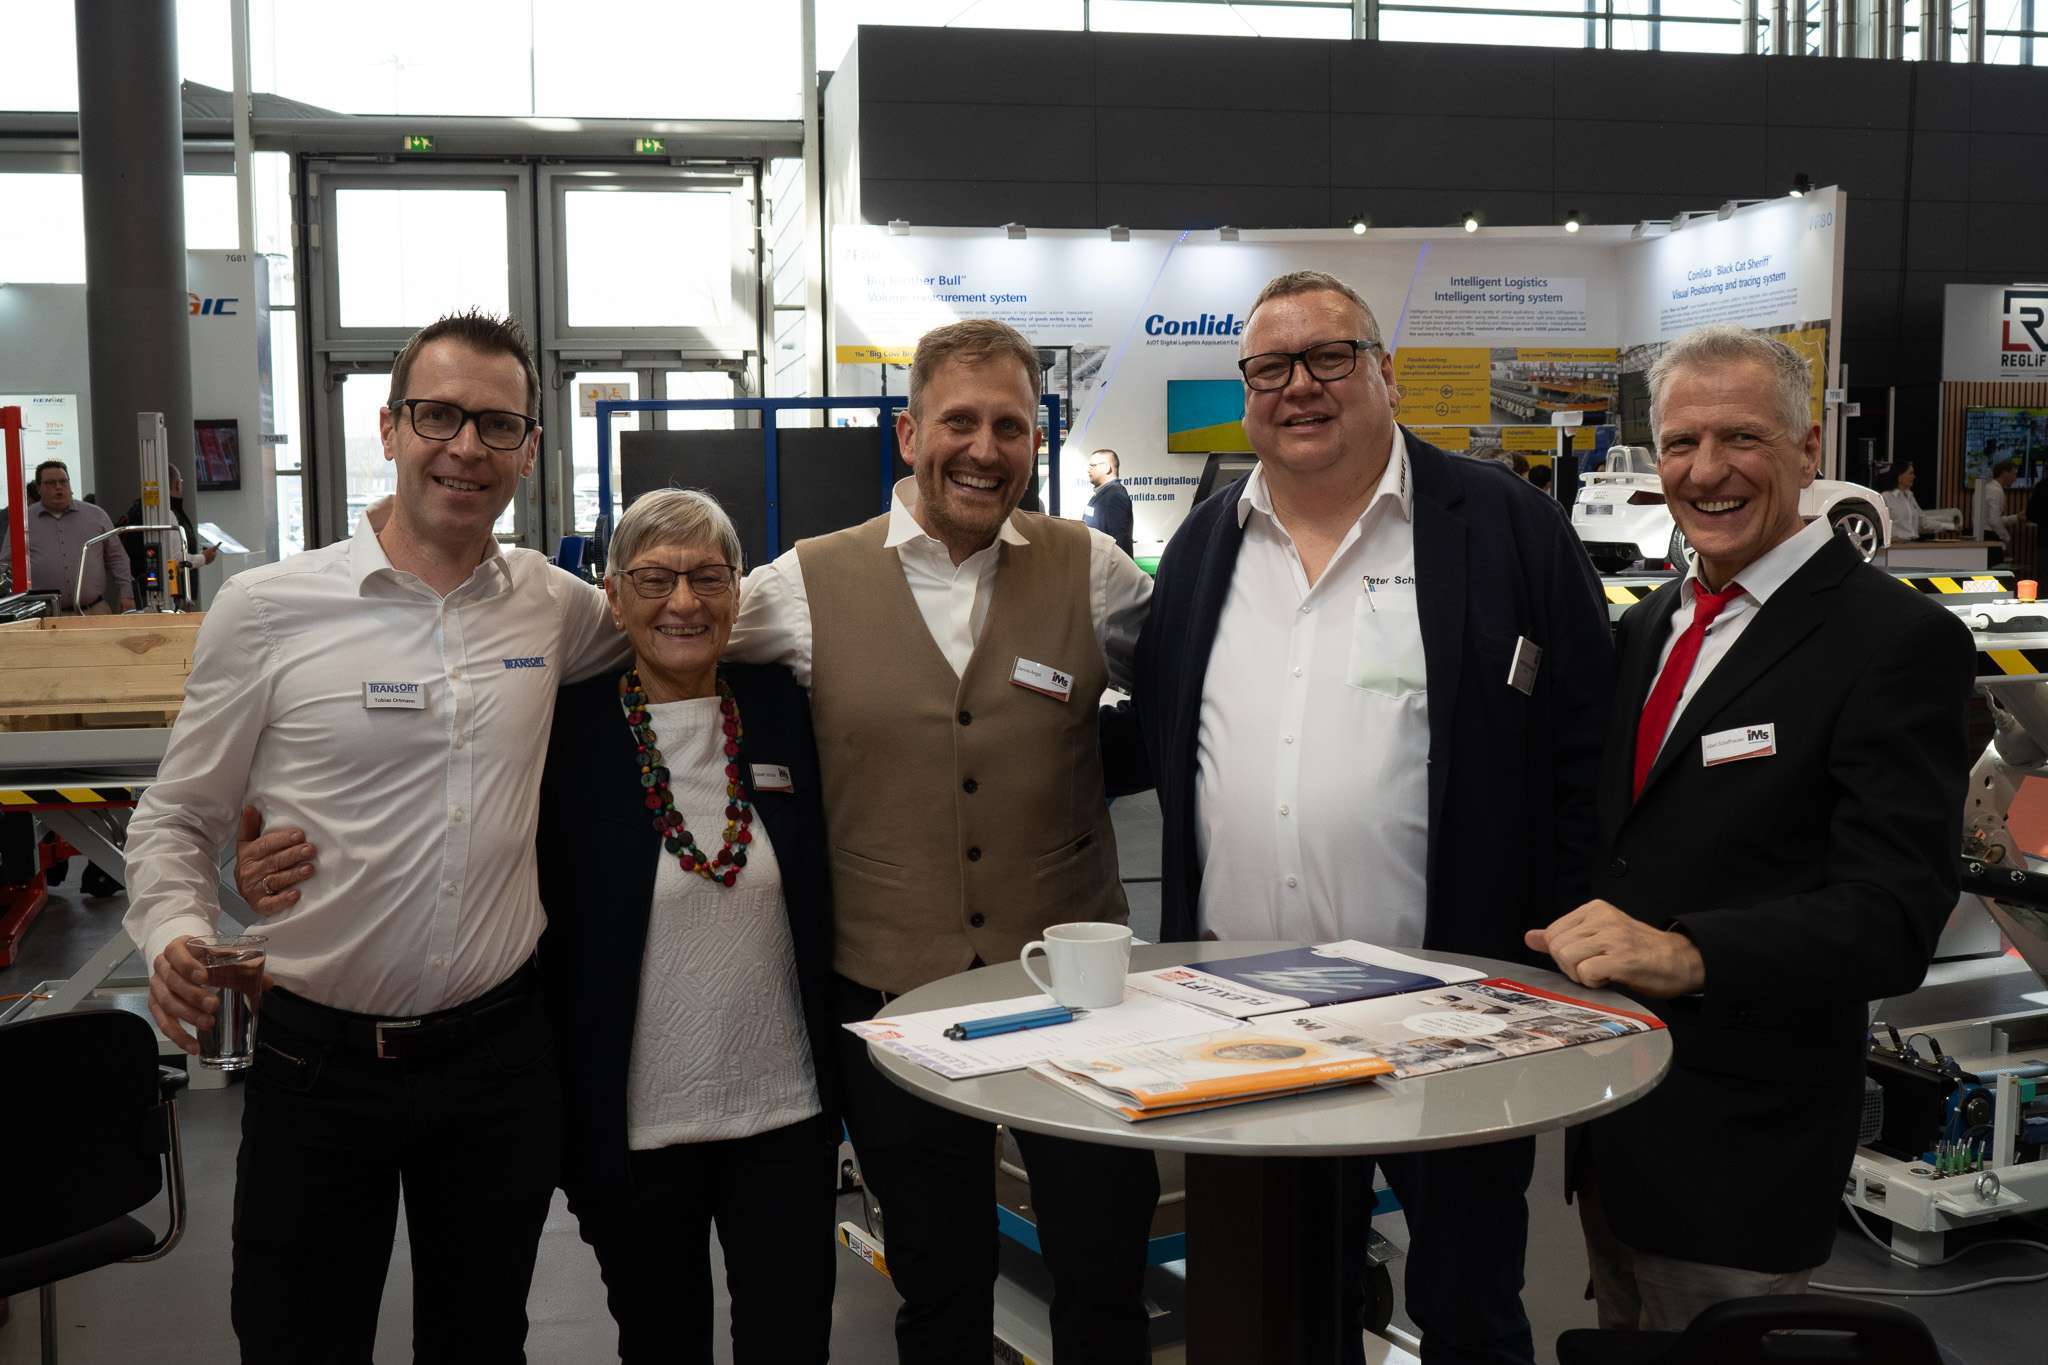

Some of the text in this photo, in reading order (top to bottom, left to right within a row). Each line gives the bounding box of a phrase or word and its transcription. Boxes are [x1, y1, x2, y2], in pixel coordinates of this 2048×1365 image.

[225, 254, 247, 263] 7G81
[1688, 269, 1712, 281] Conlida
[1735, 261, 1746, 273] Cat
[1450, 277, 1548, 289] Intelligent Logistics
[1672, 271, 1787, 300] Visual Positioning and tracing system
[990, 293, 1027, 305] system
[1434, 291, 1563, 304] Intelligent sorting system
[1145, 313, 1244, 336] Conlida
[1124, 477, 1132, 486] of
[1133, 476, 1153, 486] AIOT
[502, 656, 546, 669] TRANSORT
[368, 683, 419, 694] TRANSORT
